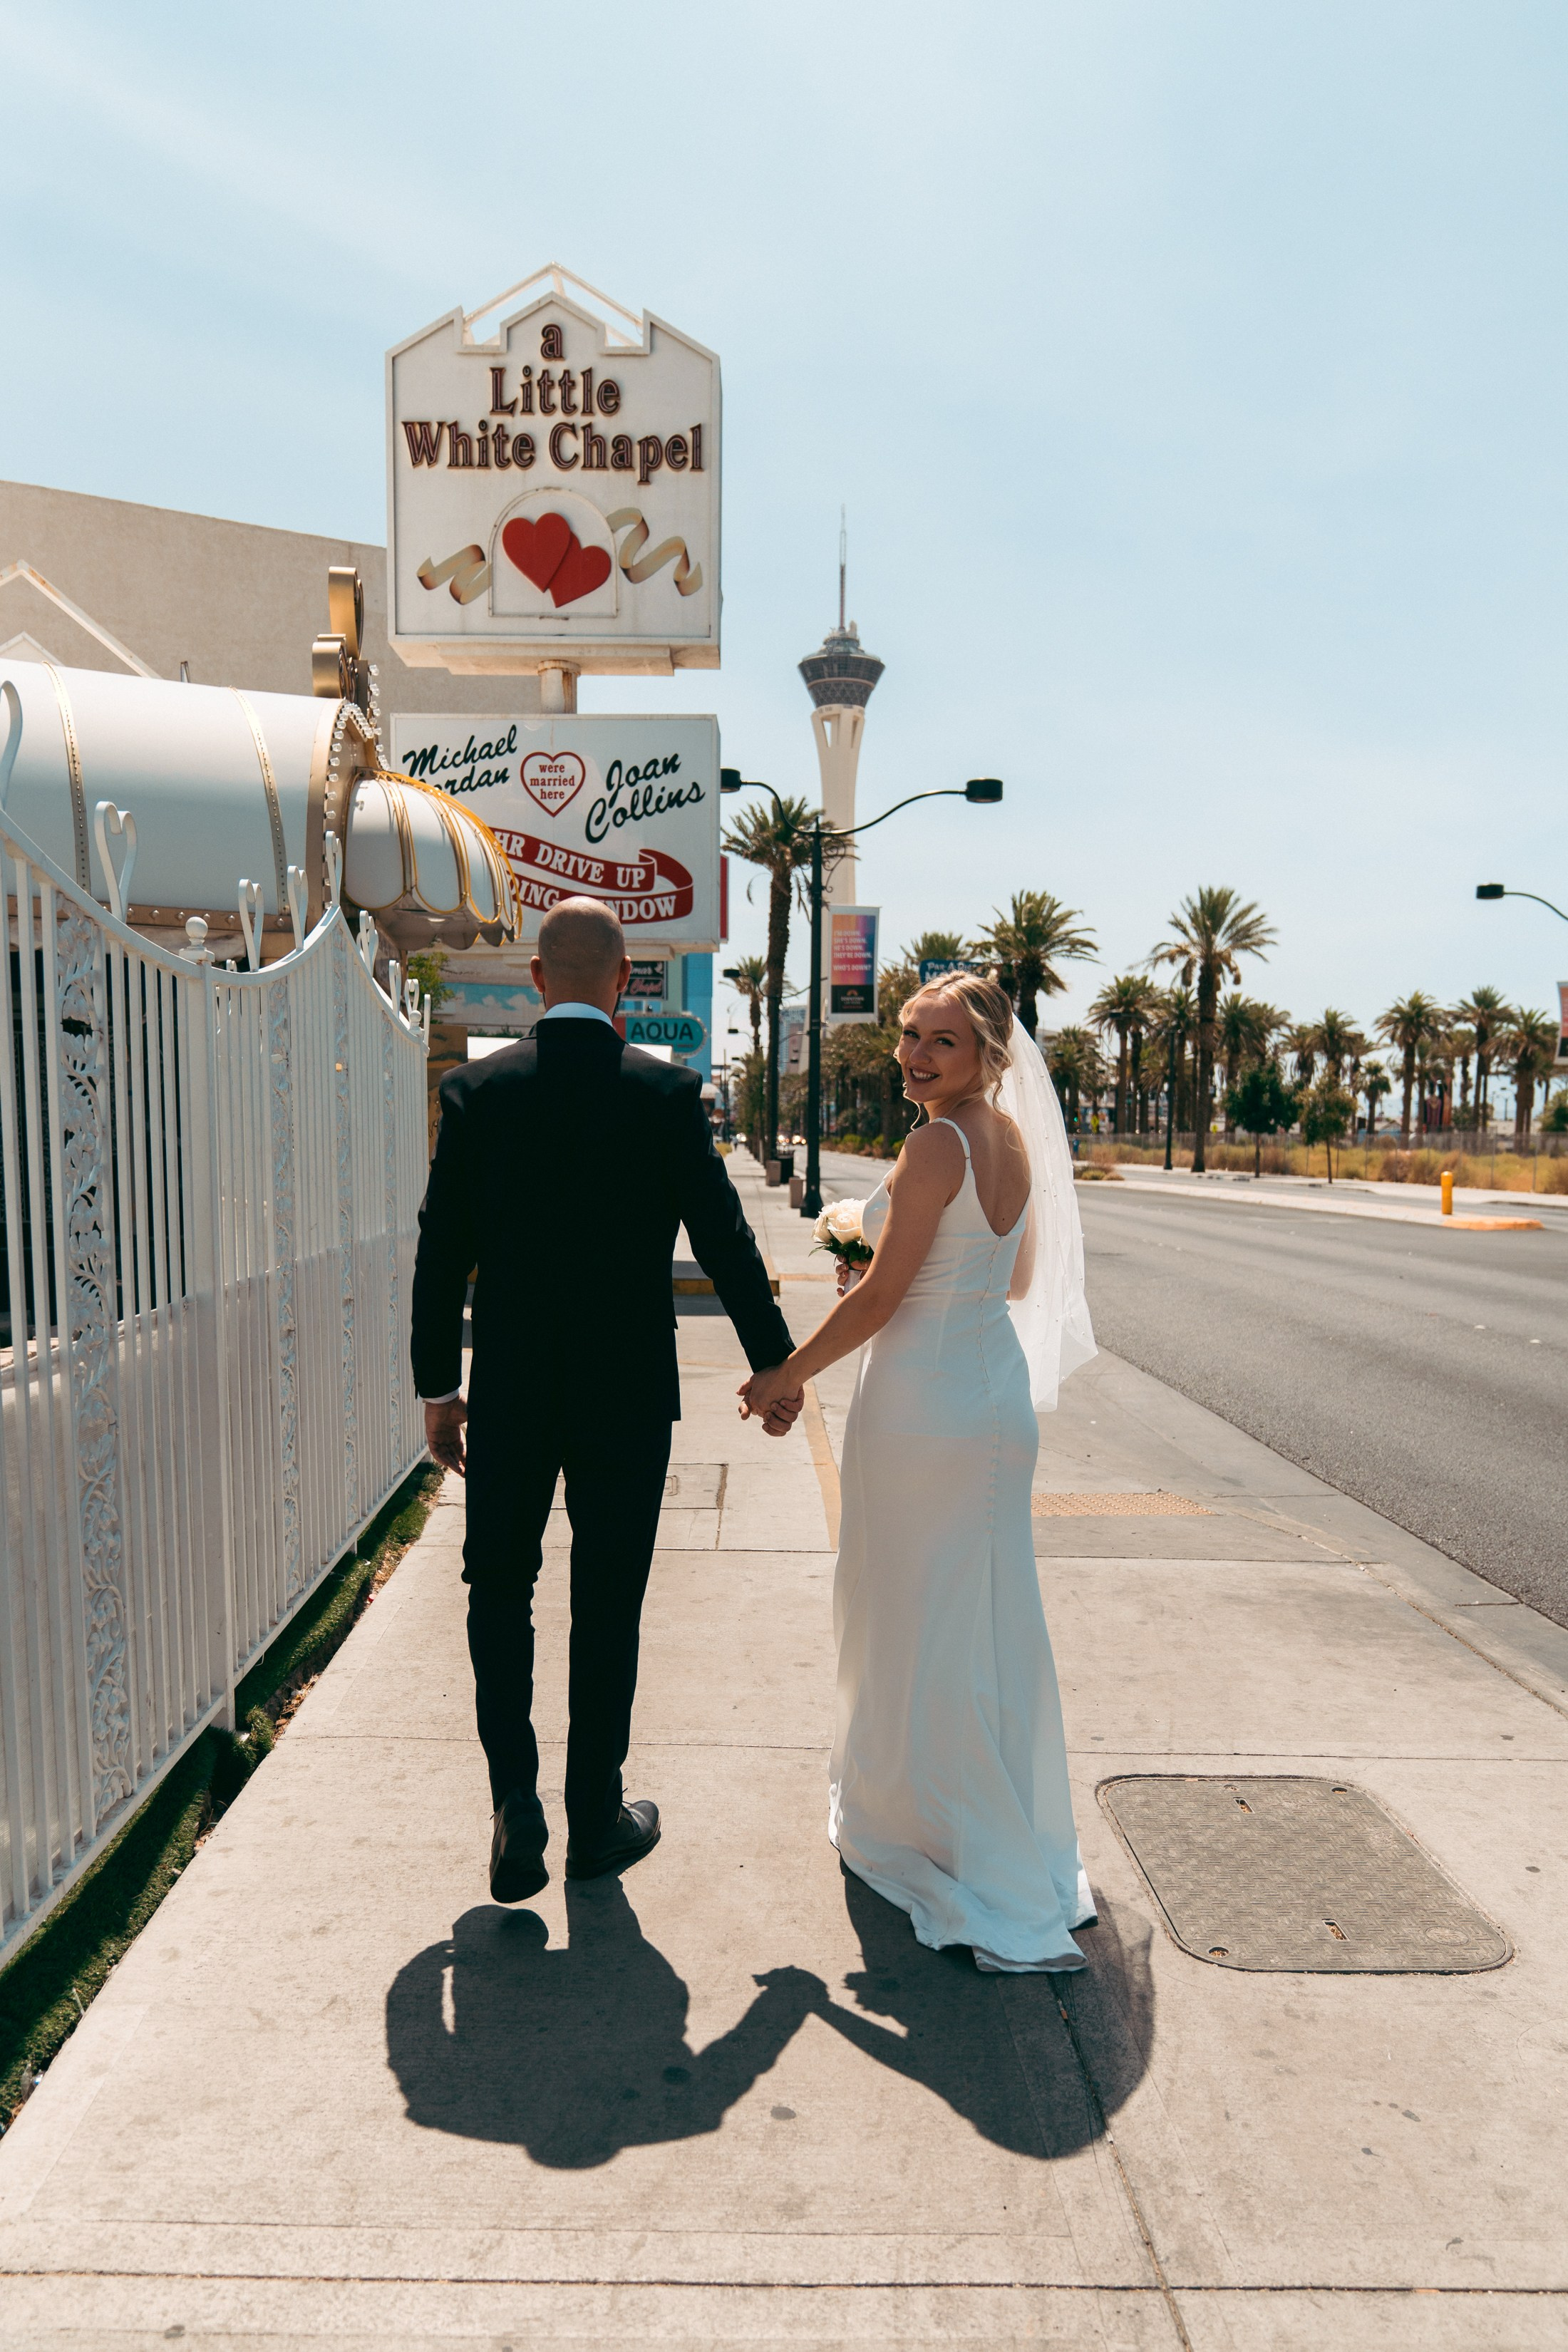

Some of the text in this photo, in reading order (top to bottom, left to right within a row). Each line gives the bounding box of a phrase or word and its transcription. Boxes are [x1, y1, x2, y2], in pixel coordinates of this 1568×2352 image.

[540, 324, 564, 361] a
[489, 365, 621, 416] Little
[401, 420, 704, 485] White Chapel
[402, 724, 517, 778] Michael
[539, 764, 564, 773] were
[530, 775, 575, 787] married
[540, 788, 564, 800] here
[607, 753, 681, 809] Joan
[585, 781, 706, 844] Collins
[535, 843, 604, 884] DRIVE
[617, 867, 646, 888] UP
[631, 1022, 693, 1042] AQUA
